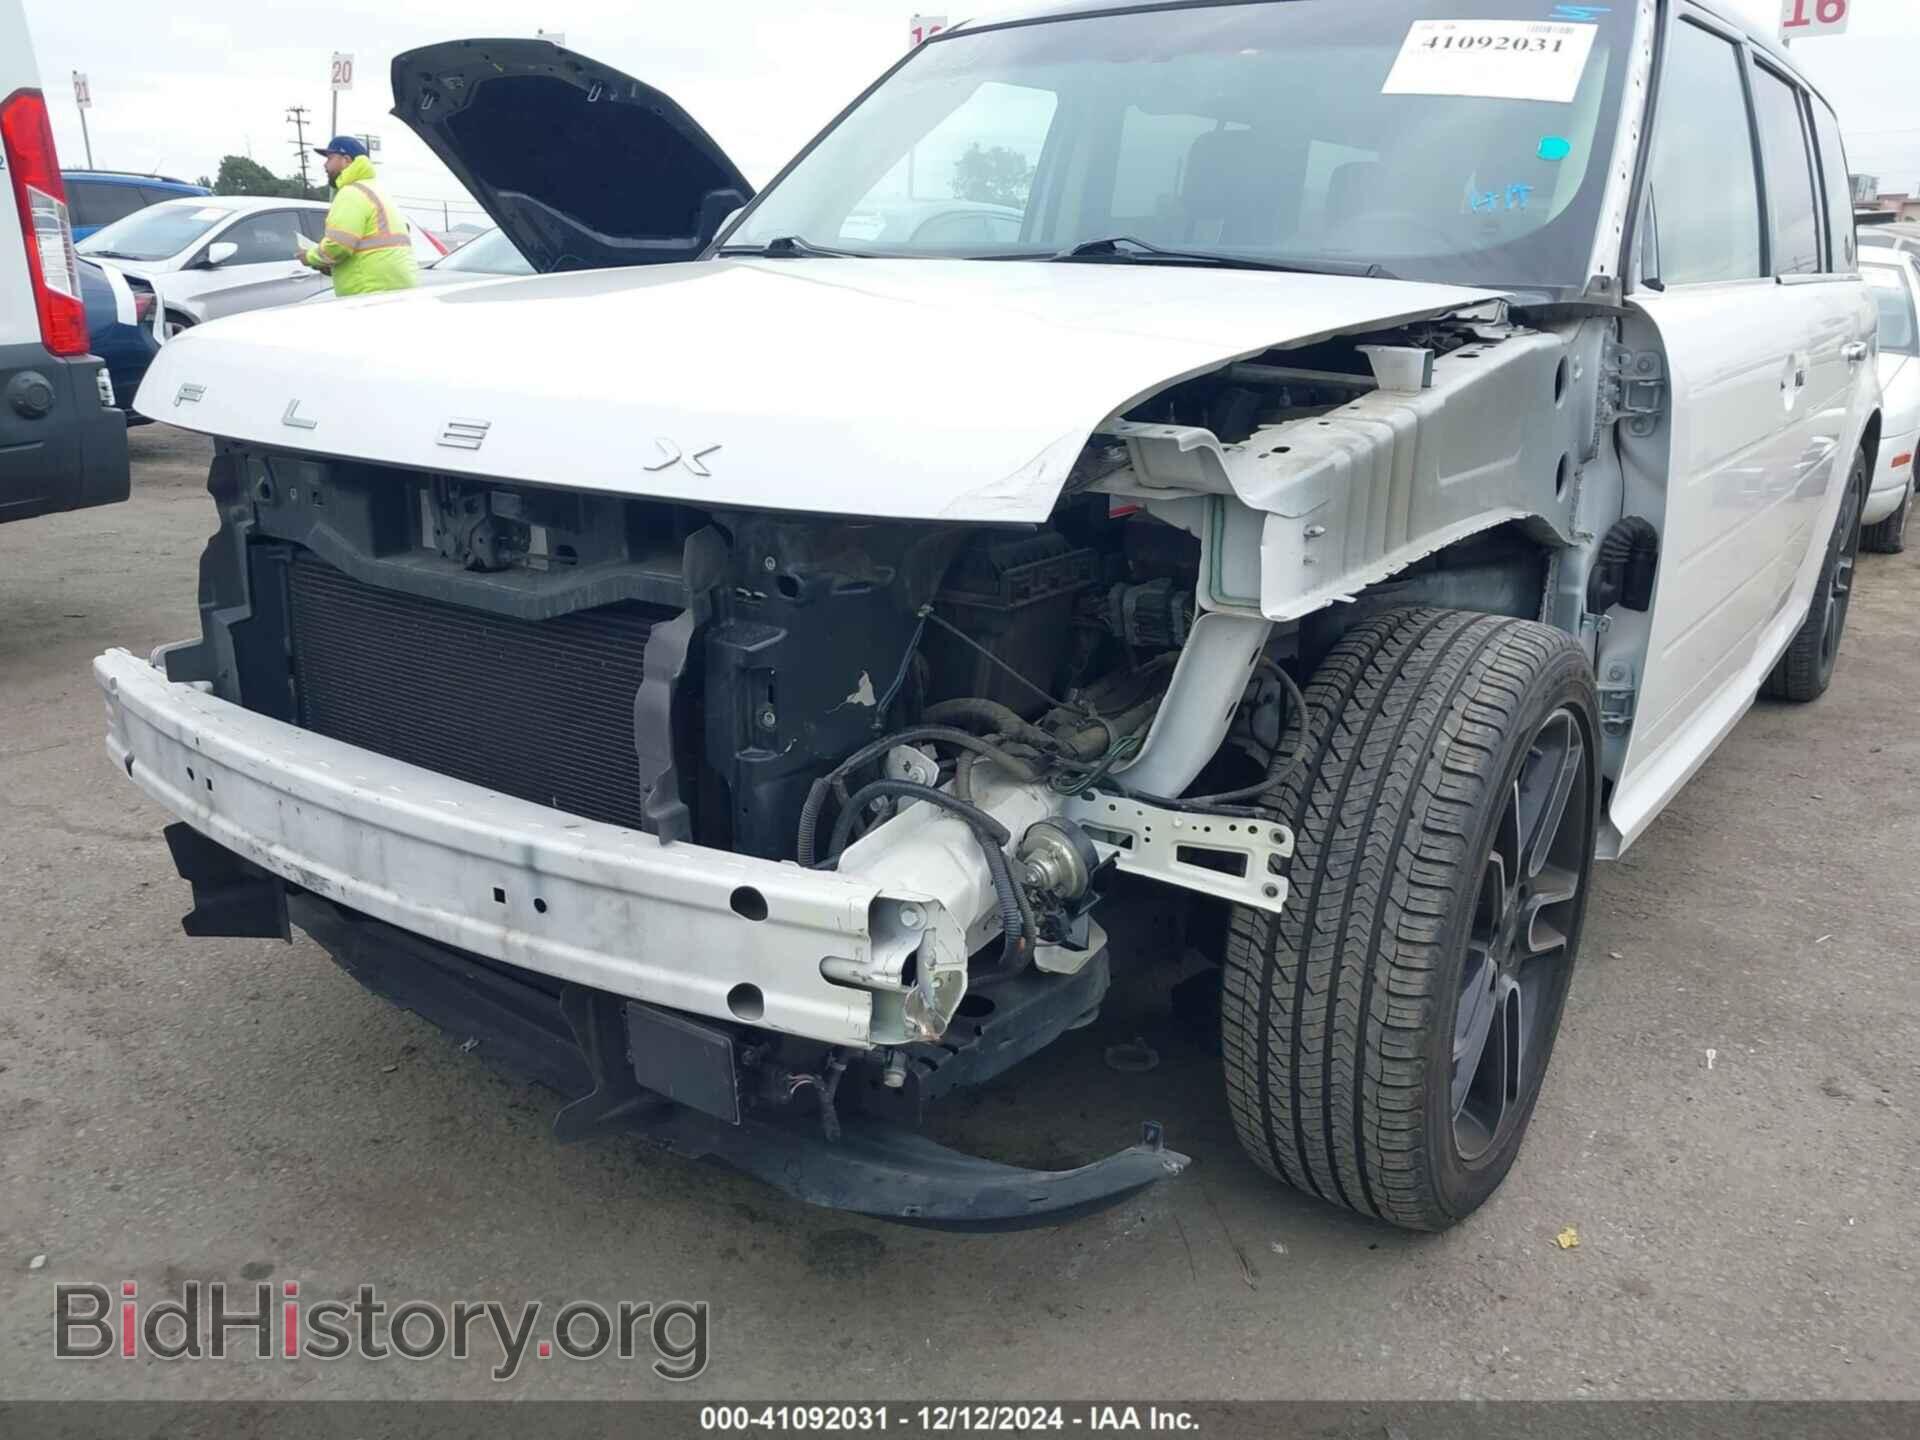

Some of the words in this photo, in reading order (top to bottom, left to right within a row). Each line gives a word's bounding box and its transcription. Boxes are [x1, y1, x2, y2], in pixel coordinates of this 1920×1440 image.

[1783, 0, 1846, 27] 16
[1421, 35, 1564, 53] 41092031
[332, 60, 352, 84] 20
[74, 80, 90, 103] 21
[174, 382, 722, 477] FLEX
